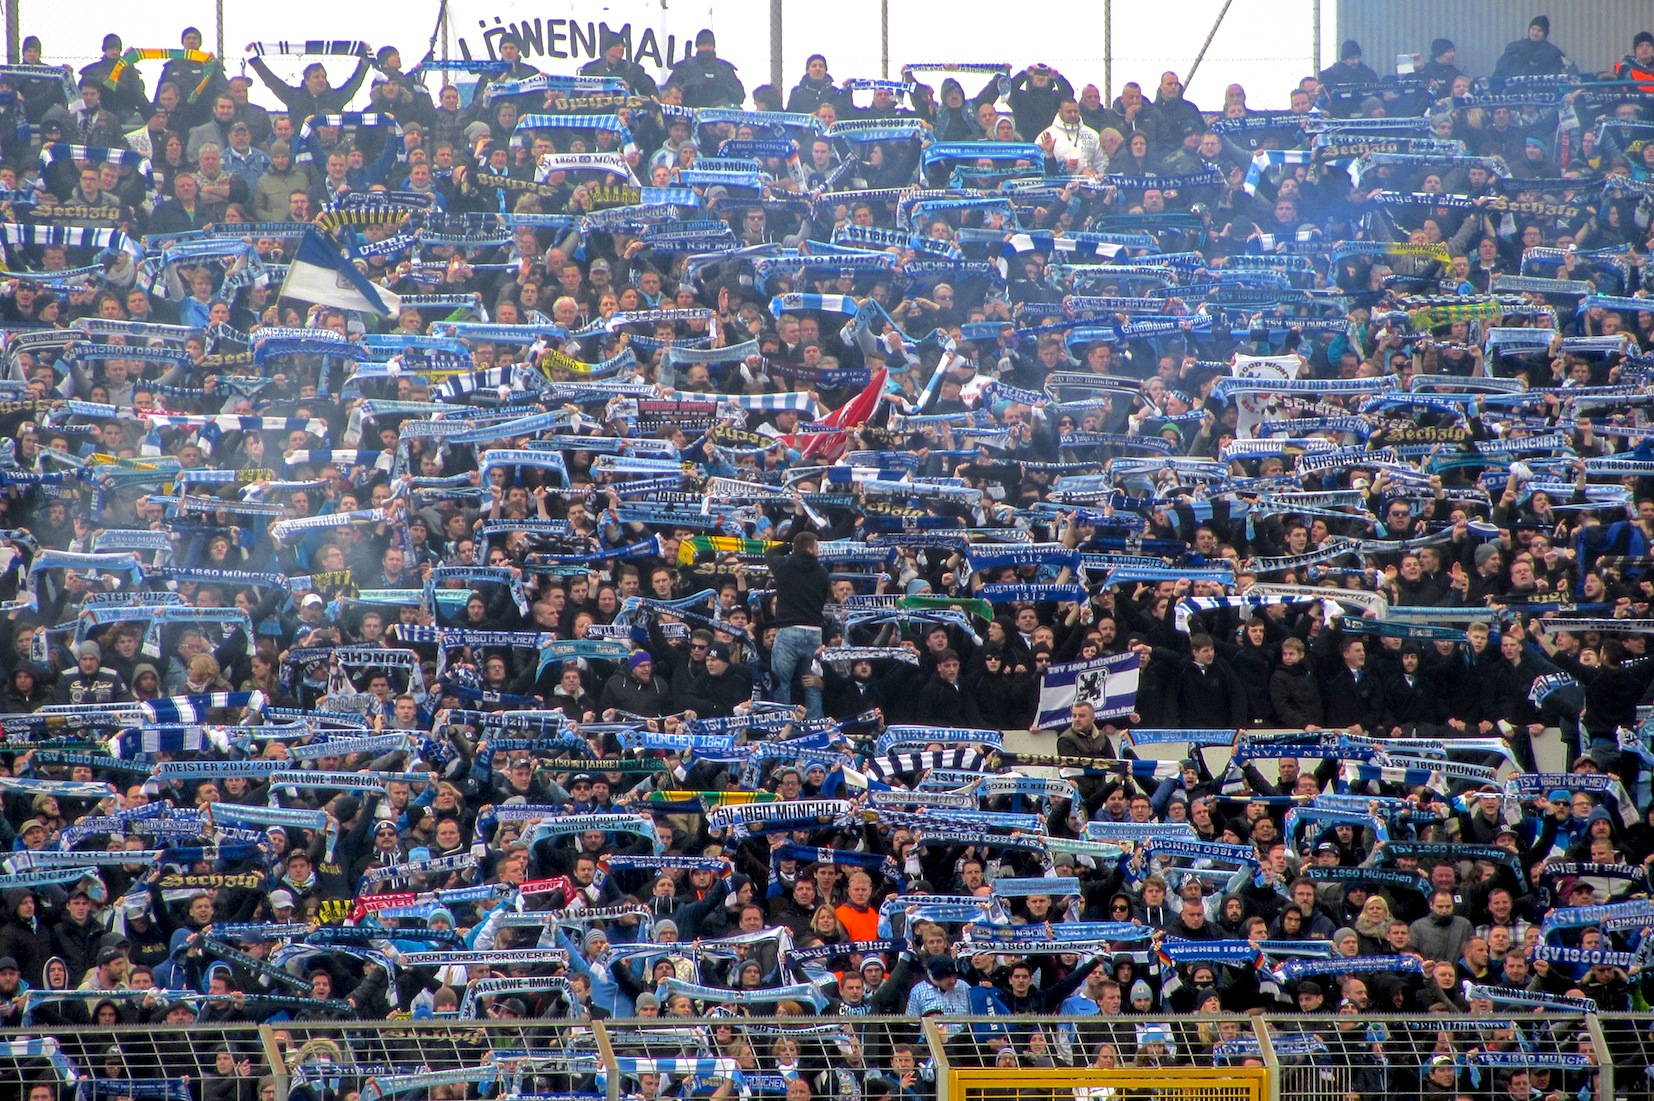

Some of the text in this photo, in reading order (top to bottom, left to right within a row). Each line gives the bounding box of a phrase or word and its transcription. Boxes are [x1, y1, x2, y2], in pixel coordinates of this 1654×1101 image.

[1322, 142, 1398, 156] Sechzig
[30, 204, 121, 219] Sechzig
[1486, 199, 1580, 218] Sechzig
[959, 263, 990, 272] 1860
[1255, 379, 1287, 390] TREU
[1306, 379, 1330, 389] DIR
[539, 390, 575, 401] Feeling
[1384, 426, 1467, 442] Sechzig
[1606, 461, 1631, 470] 1860
[1012, 555, 1043, 563] 1312
[1015, 592, 1046, 601] 1312
[895, 729, 970, 742] TREU ZU DIR
[37, 751, 61, 763] TSV
[62, 753, 91, 766] 1860
[164, 762, 286, 772] MEISTER 2012/2013
[1413, 759, 1441, 772] 1860
[933, 772, 957, 782] TSV
[1518, 776, 1537, 786] TSV
[1540, 776, 1561, 786] 1860
[981, 782, 1064, 793] ECHTER SECHZGER
[737, 805, 773, 823] 1860
[775, 800, 843, 820] MÜNCHEN
[554, 815, 635, 824] Löwenfanclub
[547, 822, 642, 835] Neumarkt-St. Veit
[982, 833, 1017, 844] 1860
[1205, 842, 1233, 855] 1860
[1389, 844, 1506, 859] TSV 1860 München
[159, 872, 260, 889] Sechzig
[1309, 868, 1413, 884] TSV 1860 München
[442, 889, 489, 903] ALONE
[366, 898, 416, 913] NEVER
[973, 942, 1093, 951] TSV 1860 München
[1169, 945, 1251, 954] MÜNCHEN 1860
[204, 938, 227, 953] TSV
[228, 949, 260, 969] 1860
[450, 952, 563, 961] UND SPORTVEREIN
[1563, 948, 1600, 963] 1860
[1488, 986, 1522, 1000] EINMAL
